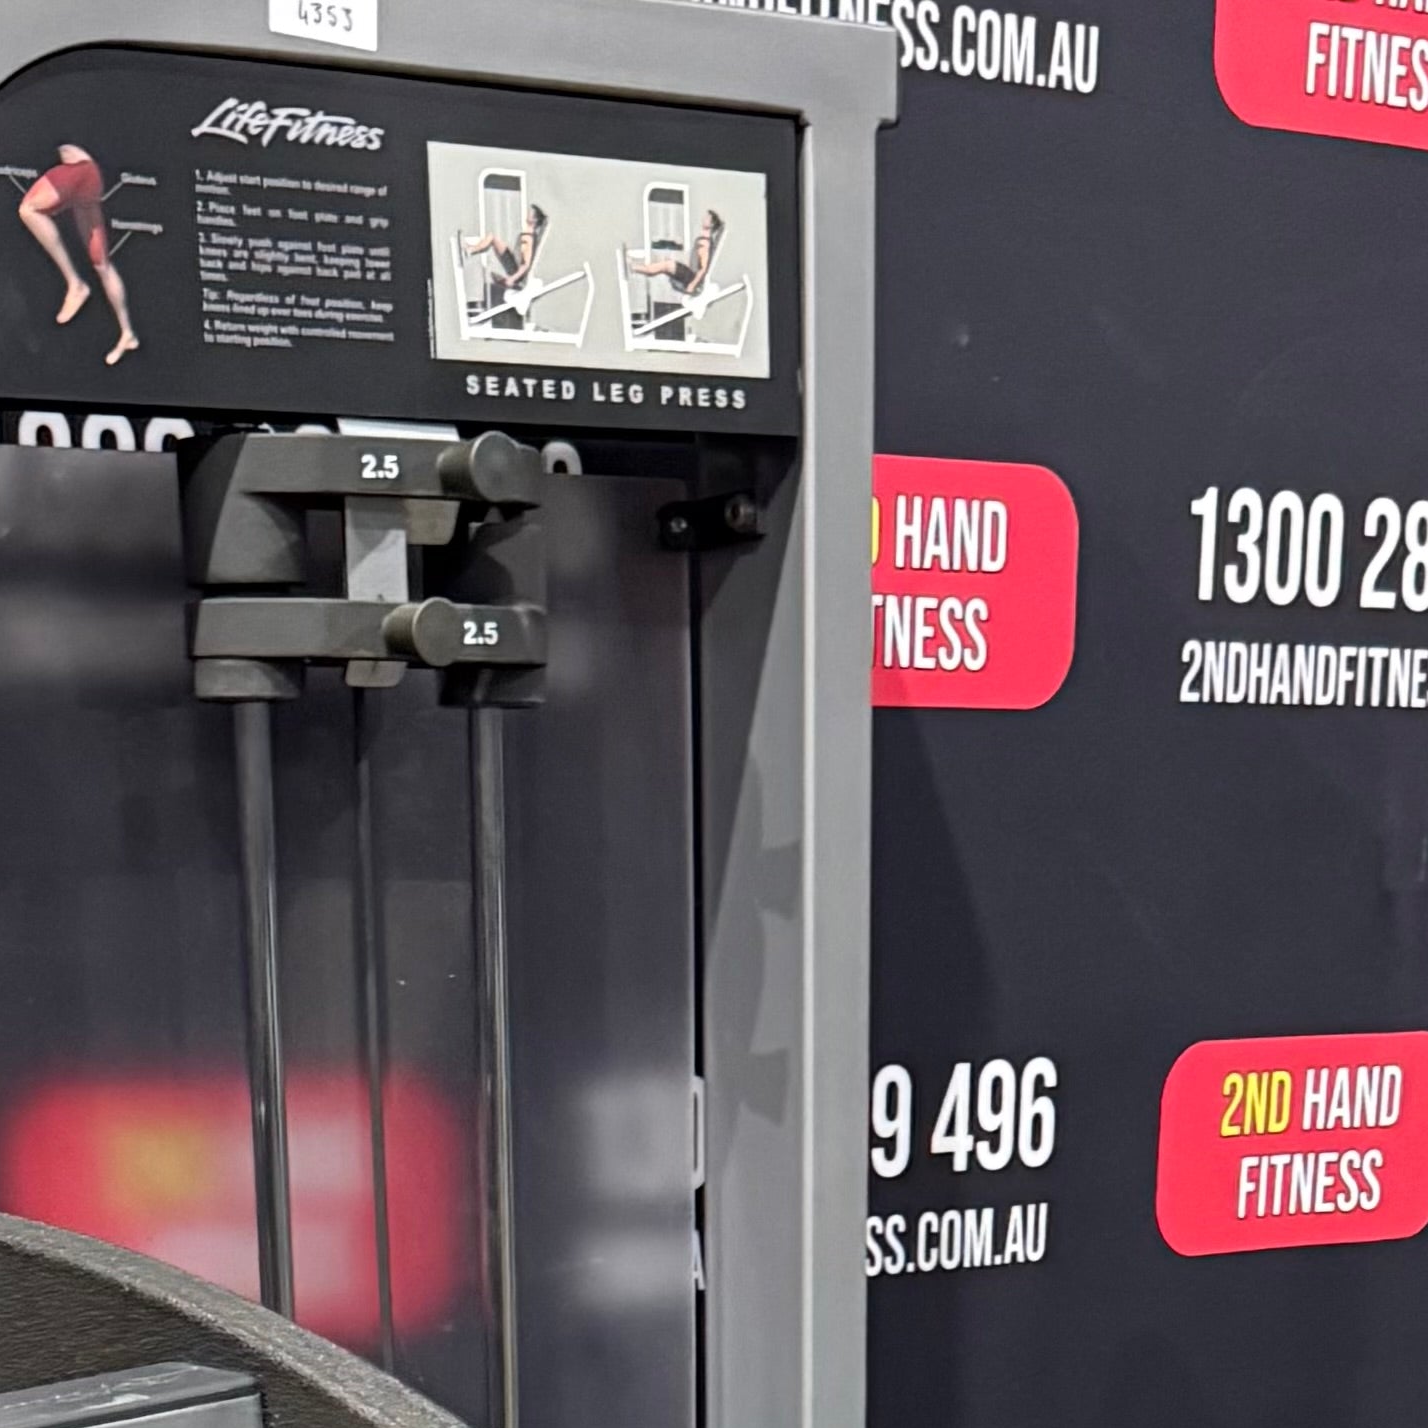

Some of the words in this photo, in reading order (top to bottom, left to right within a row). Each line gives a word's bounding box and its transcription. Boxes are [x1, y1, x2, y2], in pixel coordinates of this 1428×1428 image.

[466, 374, 575, 400] SEATED
[593, 381, 644, 405] LEG
[661, 385, 746, 409] PRESS
[361, 453, 400, 479] 2.5
[894, 495, 1007, 573] HAND
[1189, 486, 1344, 608] 1300
[463, 621, 499, 645] 2.5
[930, 1056, 1058, 1172] 496
[1220, 1069, 1292, 1137] 2ND
[1301, 1064, 1403, 1131] HAND
[1236, 1148, 1383, 1220] FITNESS
